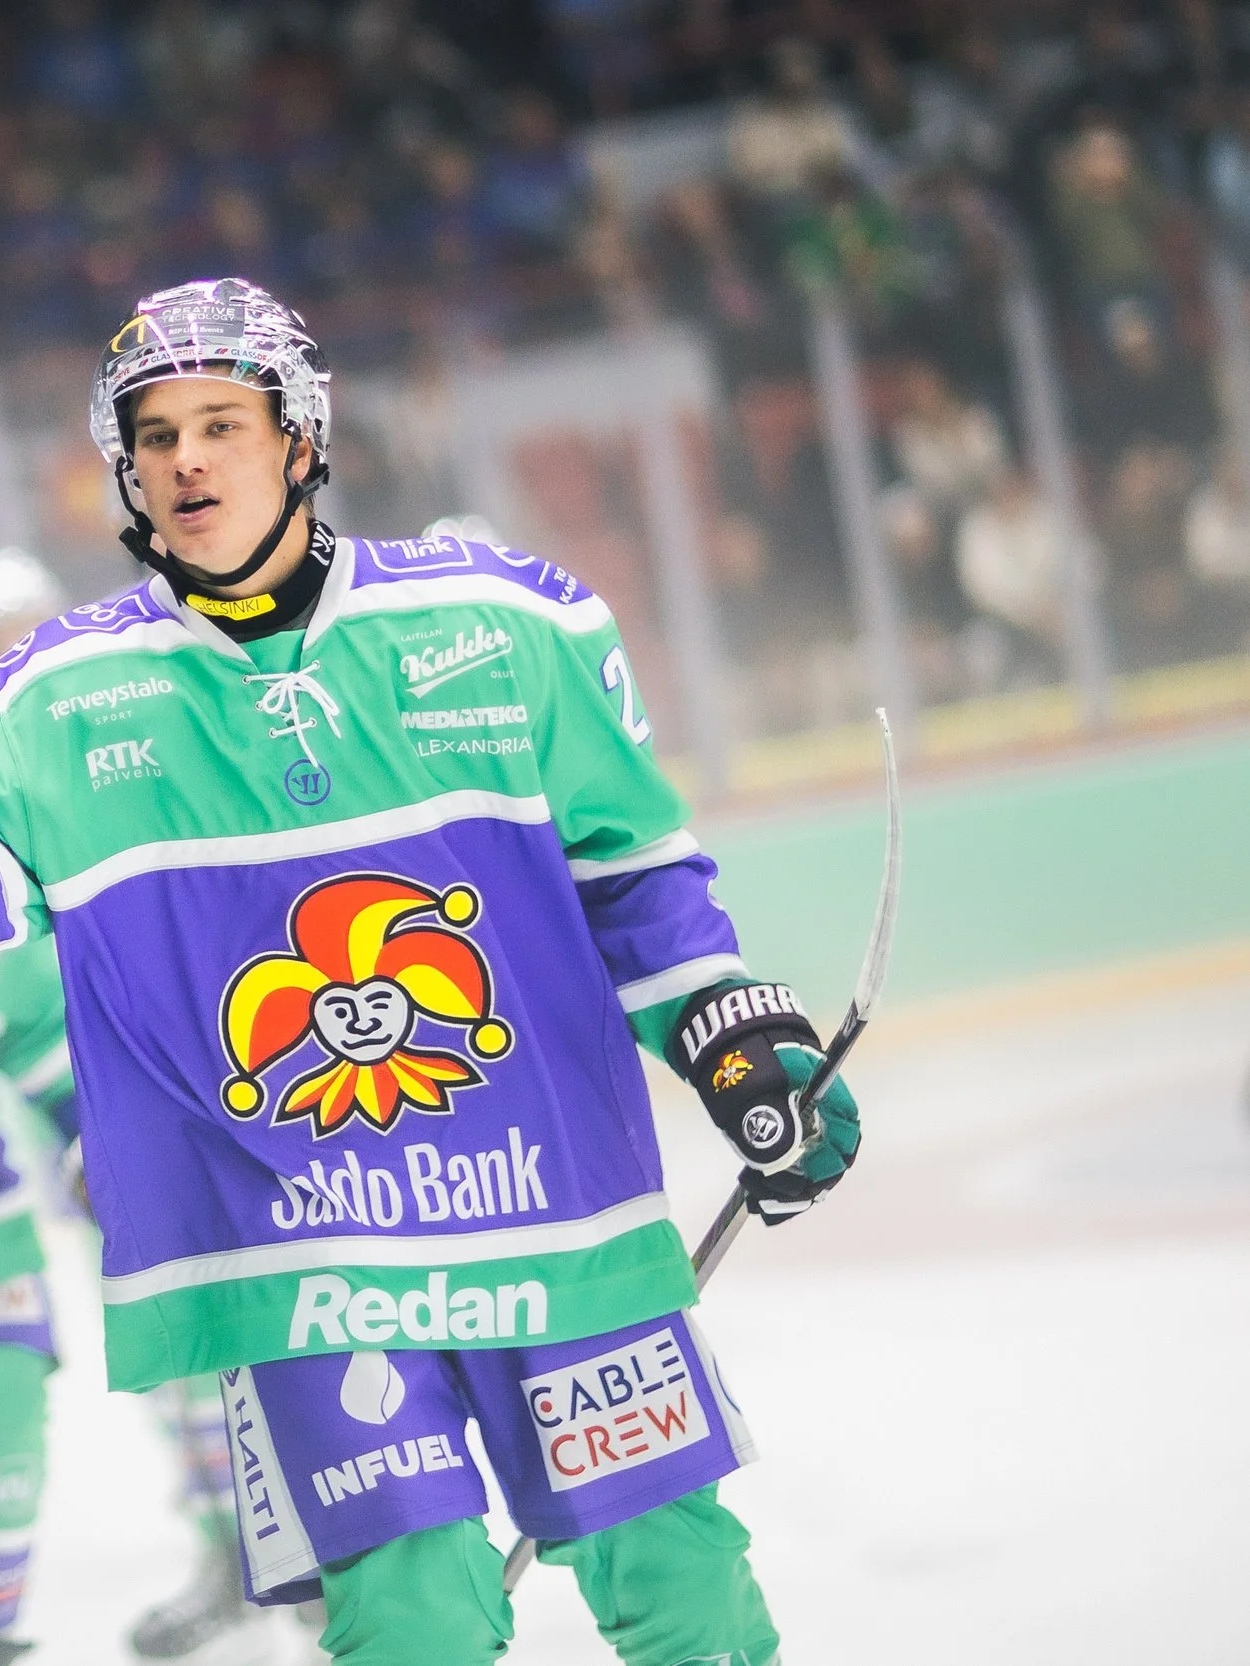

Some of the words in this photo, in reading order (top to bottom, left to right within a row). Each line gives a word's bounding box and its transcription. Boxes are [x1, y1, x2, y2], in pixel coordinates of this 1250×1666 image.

[400, 628, 443, 642] LAITILAN
[490, 670, 514, 679] OLUT
[46, 677, 173, 721] Terveystalo
[95, 710, 132, 726] SPORT
[85, 738, 160, 779] RTK
[414, 736, 533, 758] LEXANDRIA
[91, 766, 163, 793] palvelu
[403, 1126, 549, 1223] Bank
[287, 1271, 548, 1350] Redan
[530, 1340, 686, 1428] CABLE
[550, 1391, 687, 1476] CREW
[235, 1396, 281, 1541] HALTI
[311, 1434, 464, 1508] INFUEL
